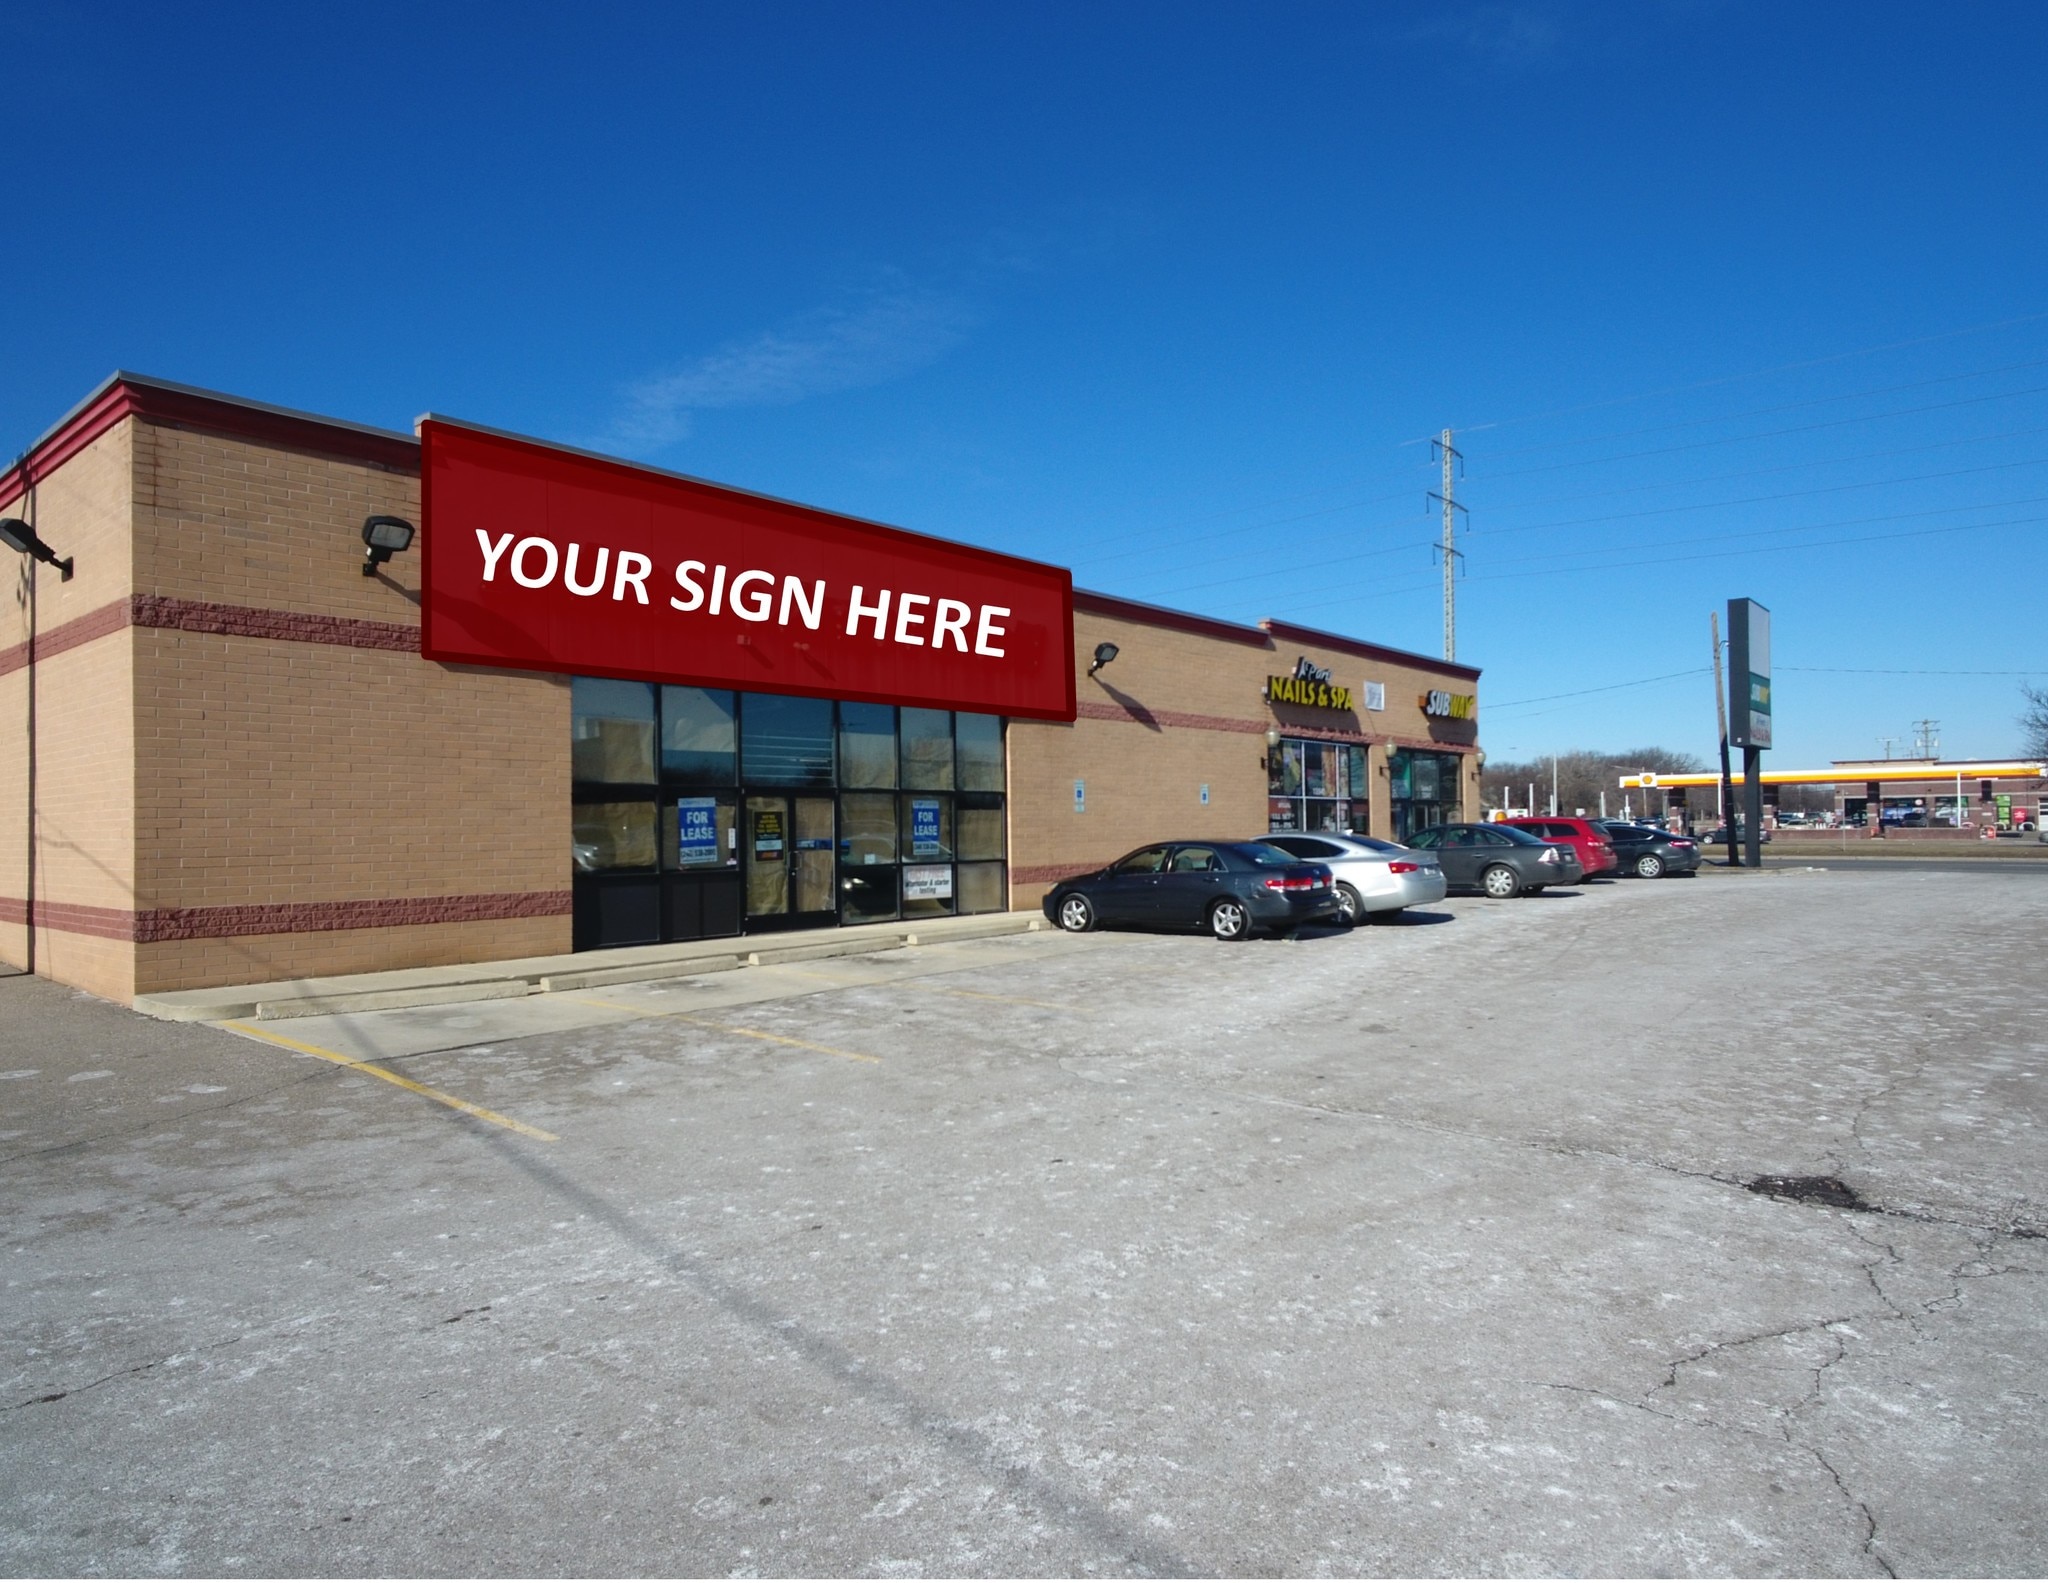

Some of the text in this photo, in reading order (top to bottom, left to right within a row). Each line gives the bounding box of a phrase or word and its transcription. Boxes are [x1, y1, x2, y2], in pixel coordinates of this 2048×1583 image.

[1271, 676, 1316, 705] NAILS
[1317, 684, 1328, 707] &
[1330, 687, 1354, 711] SPA
[1427, 690, 1474, 719] SUBWAY
[686, 811, 708, 824] FOR
[918, 812, 933, 822] FOR
[680, 827, 715, 840] LEASE
[914, 825, 938, 836] LEASE
